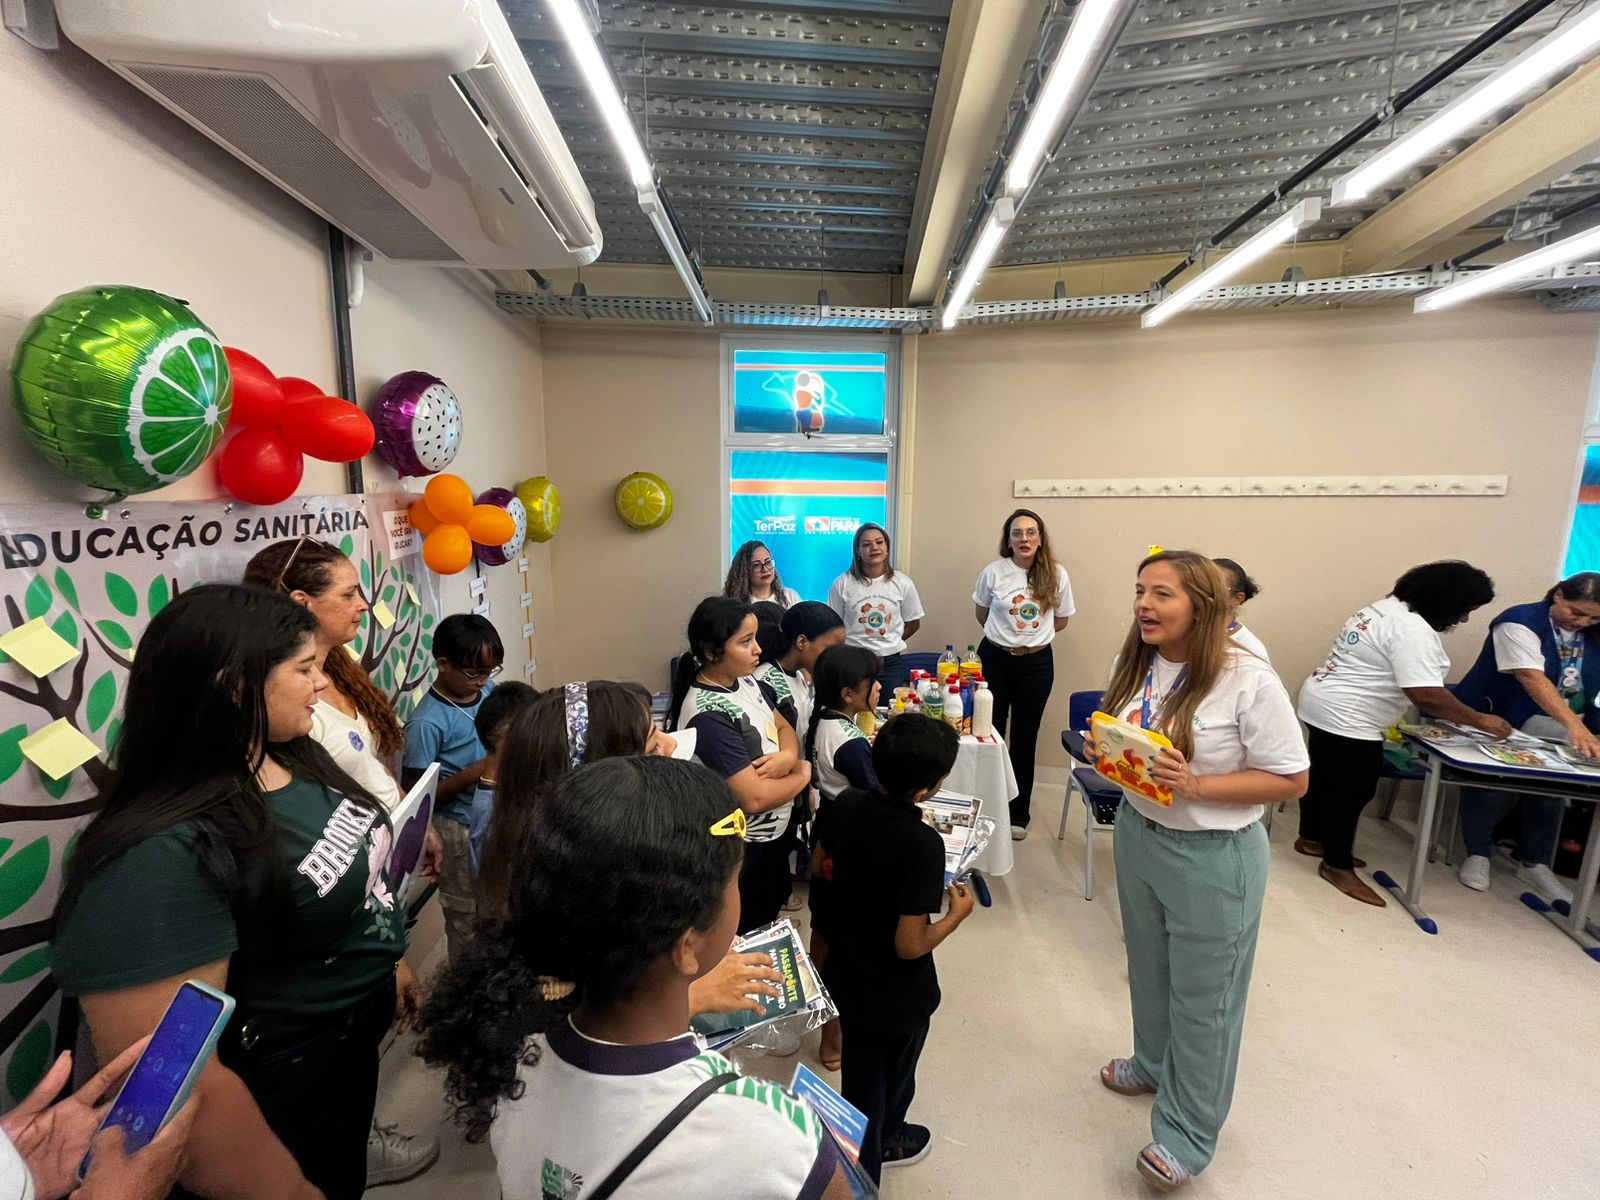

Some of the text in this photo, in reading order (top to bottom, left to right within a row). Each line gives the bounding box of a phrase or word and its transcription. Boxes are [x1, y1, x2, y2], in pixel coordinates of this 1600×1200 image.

[233, 507, 369, 543] SANITÁRIA
[754, 519, 796, 531] TerPaz
[779, 948, 798, 1002] PASSAPORTE
